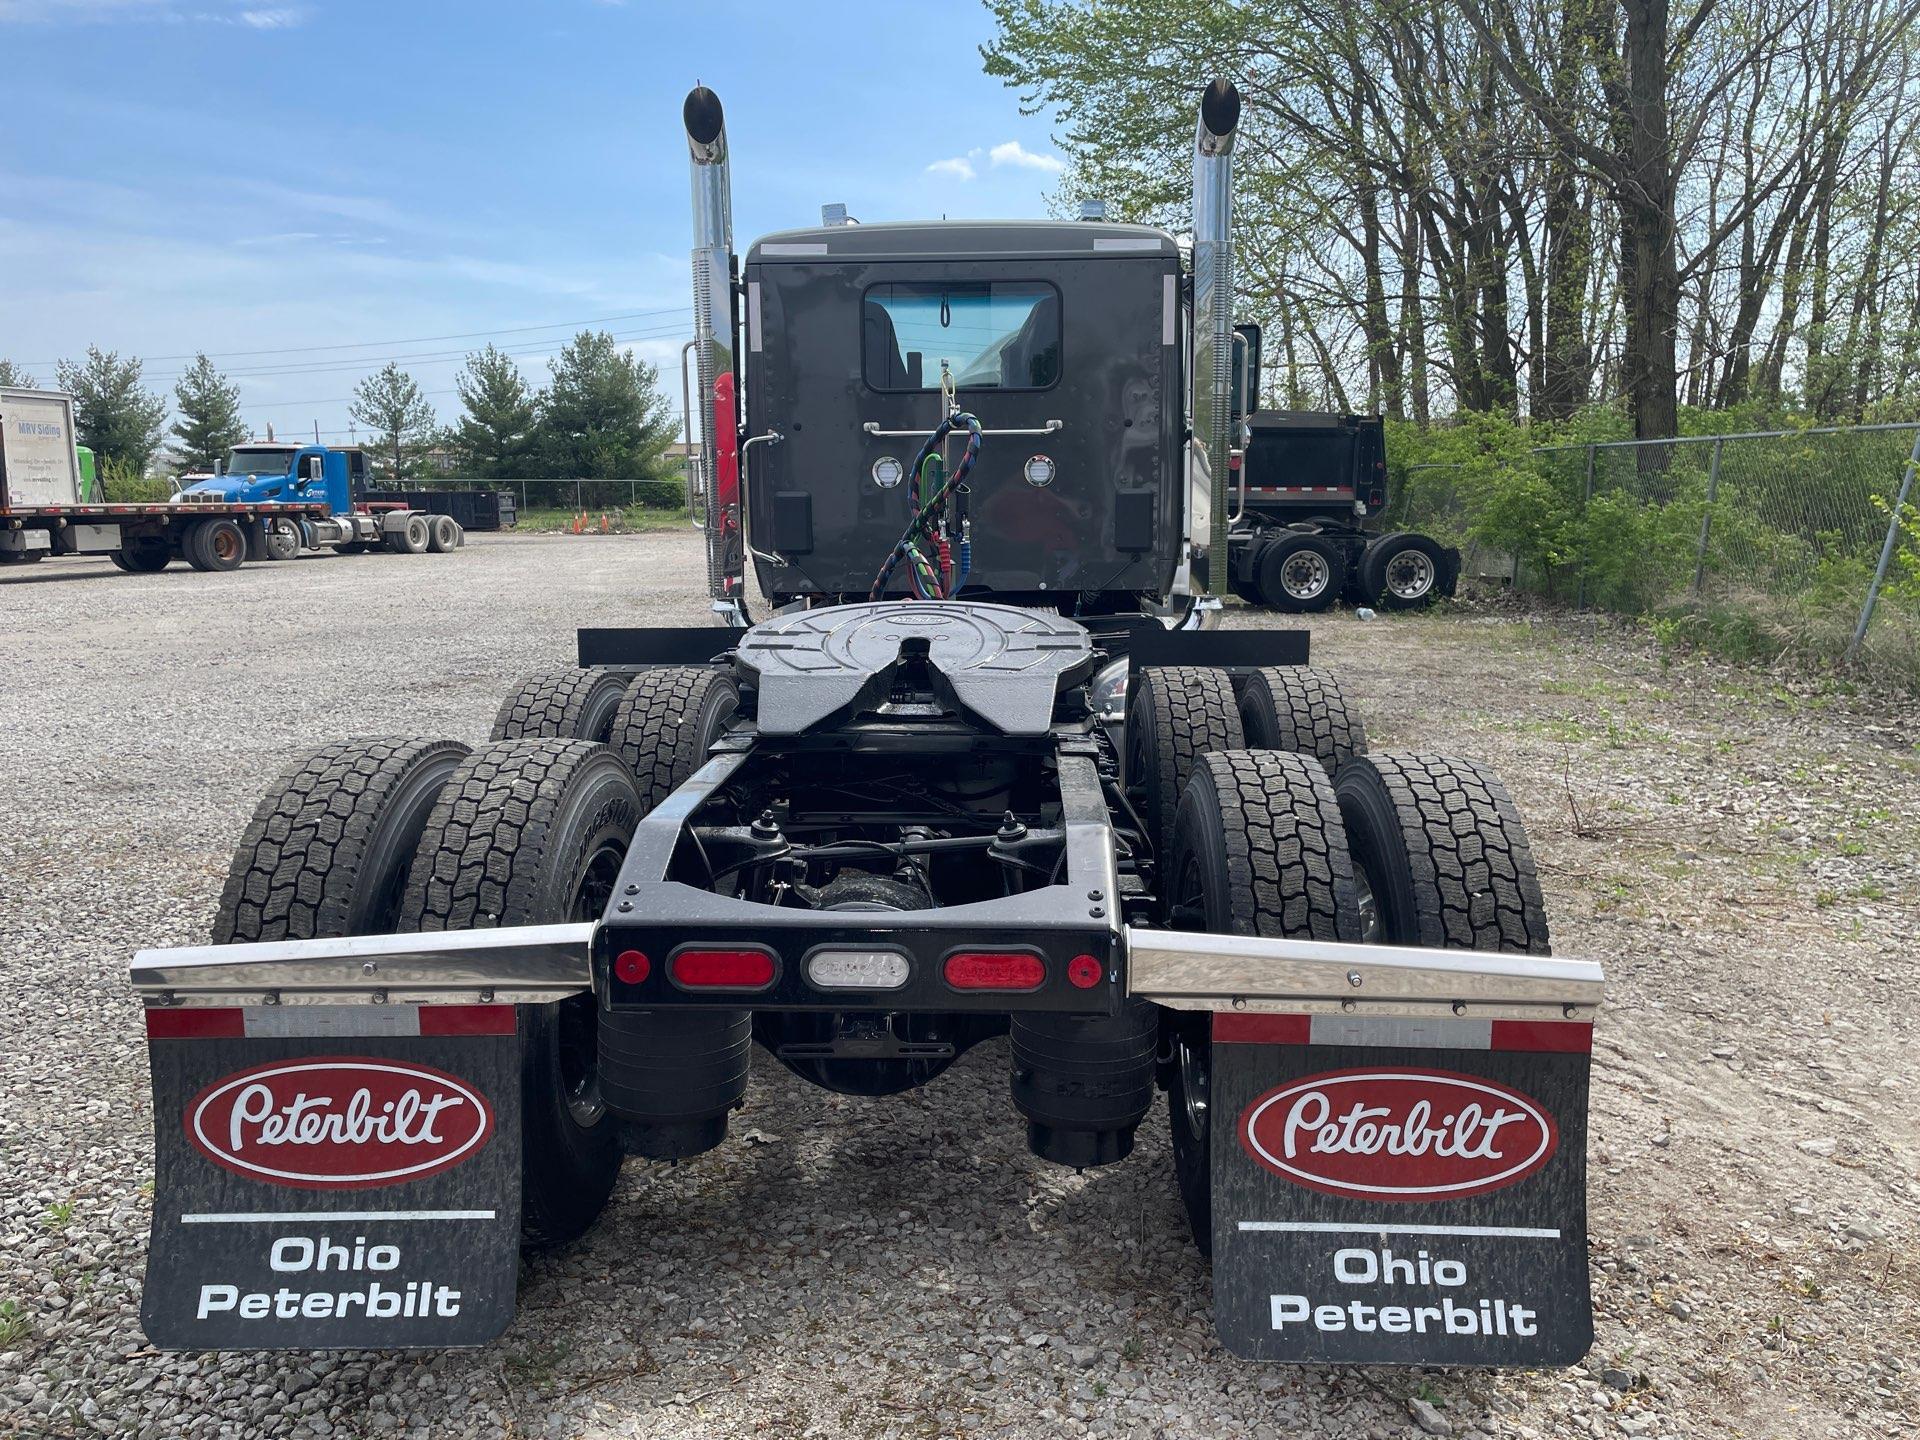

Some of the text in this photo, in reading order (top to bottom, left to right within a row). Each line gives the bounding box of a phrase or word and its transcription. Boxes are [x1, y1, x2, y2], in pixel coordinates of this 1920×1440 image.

[18, 422, 61, 438] MRV Siding
[230, 1083, 464, 1152] Peterbilt
[1283, 1091, 1527, 1159] Peterbilt
[270, 1237, 400, 1272] Ohio
[1334, 1249, 1466, 1286] Ohio
[197, 1282, 461, 1319] Peterbilt
[1270, 1295, 1537, 1337] Peterbilt
